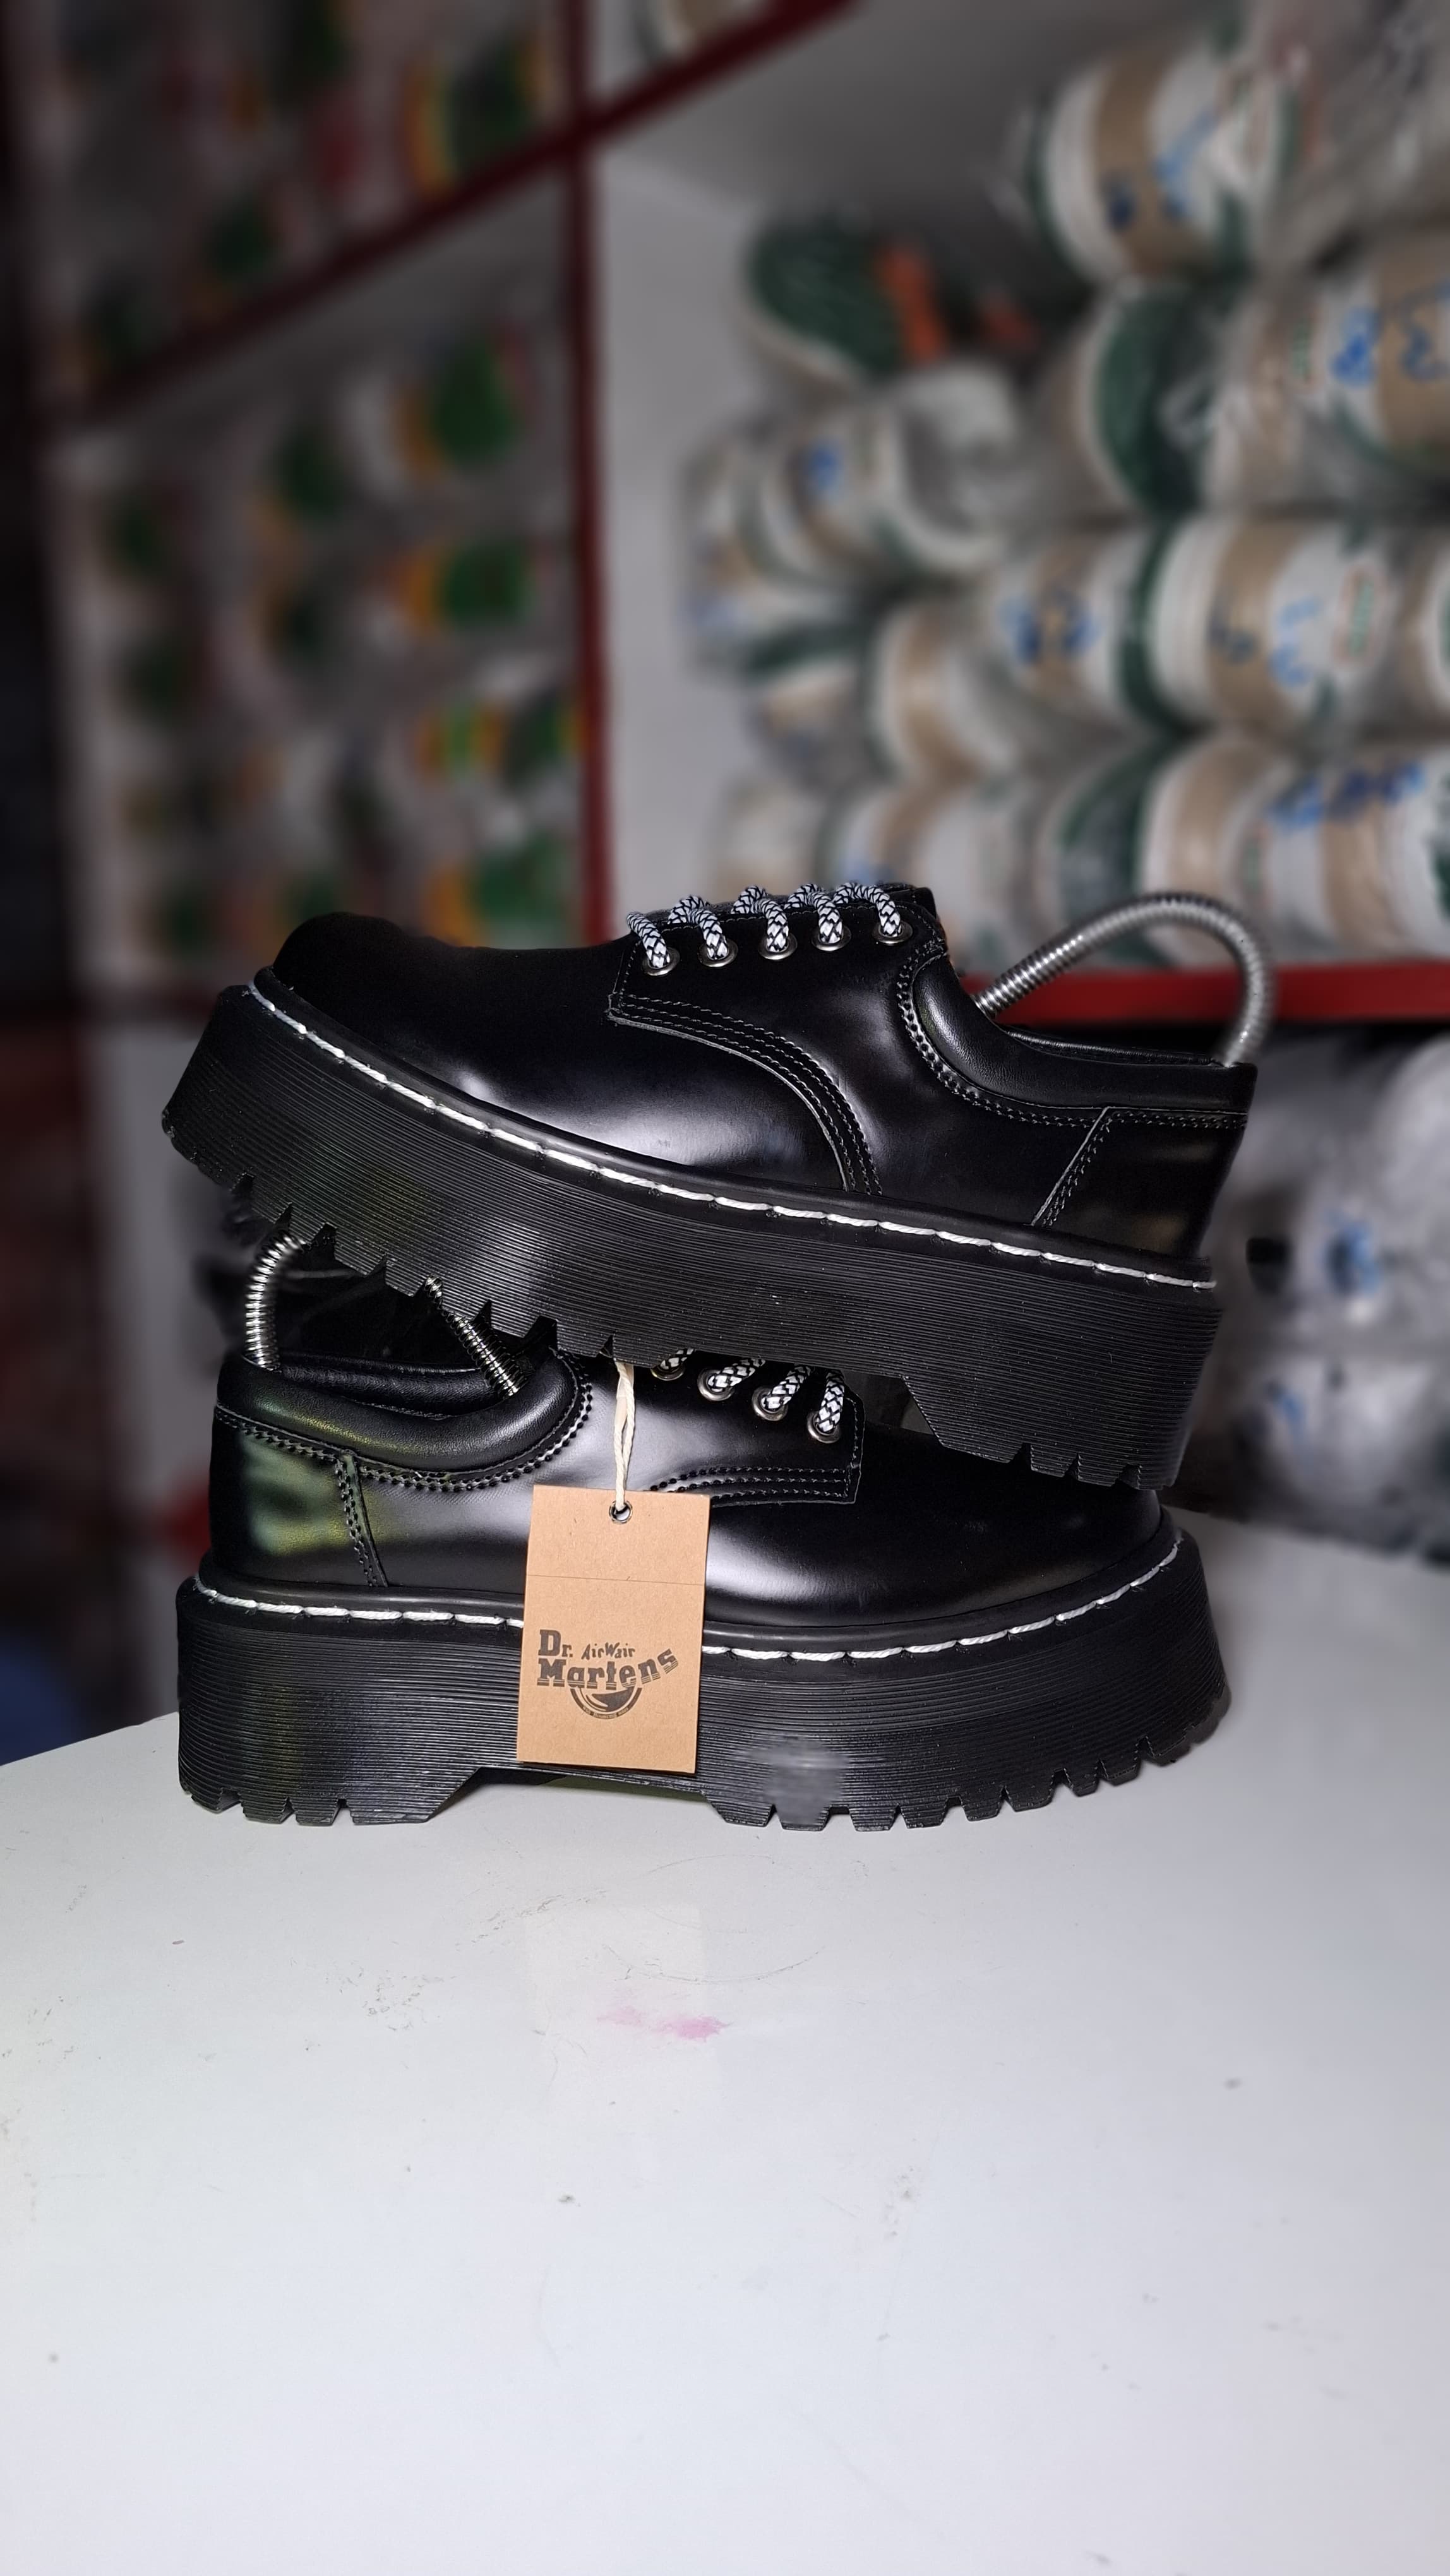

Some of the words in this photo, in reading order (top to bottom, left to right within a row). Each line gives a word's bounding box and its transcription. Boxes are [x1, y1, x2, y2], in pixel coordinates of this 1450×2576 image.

[538, 1630, 573, 1657] Dr.
[581, 1642, 636, 1661] AirWair
[537, 1649, 679, 1691] Martens
